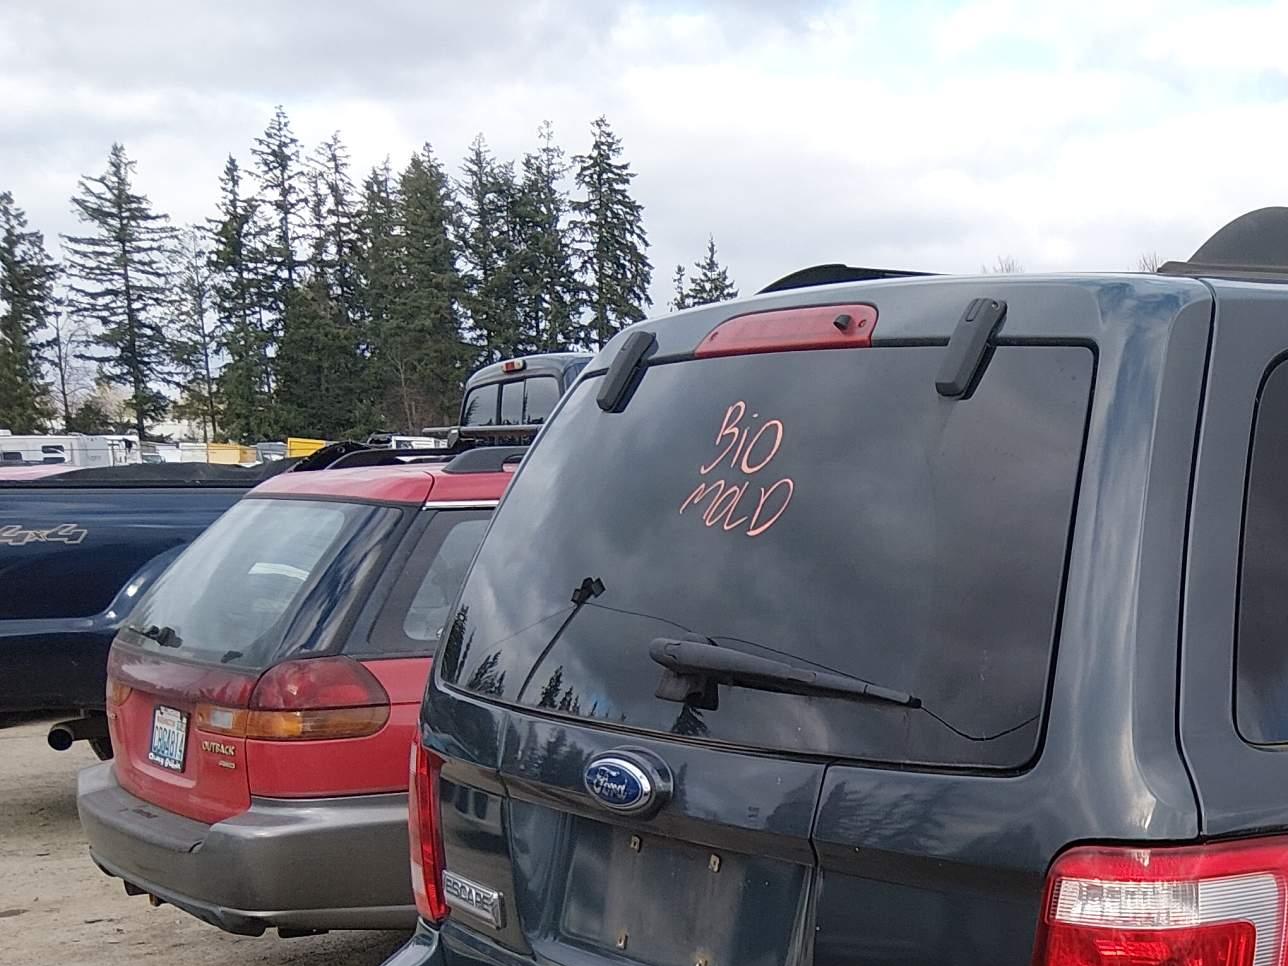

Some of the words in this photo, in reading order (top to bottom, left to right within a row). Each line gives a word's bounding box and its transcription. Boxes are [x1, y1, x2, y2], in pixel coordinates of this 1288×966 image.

[202, 741, 236, 756] OUTBACK
[593, 766, 628, 800] Ford
[446, 877, 493, 913] ESCAPE
